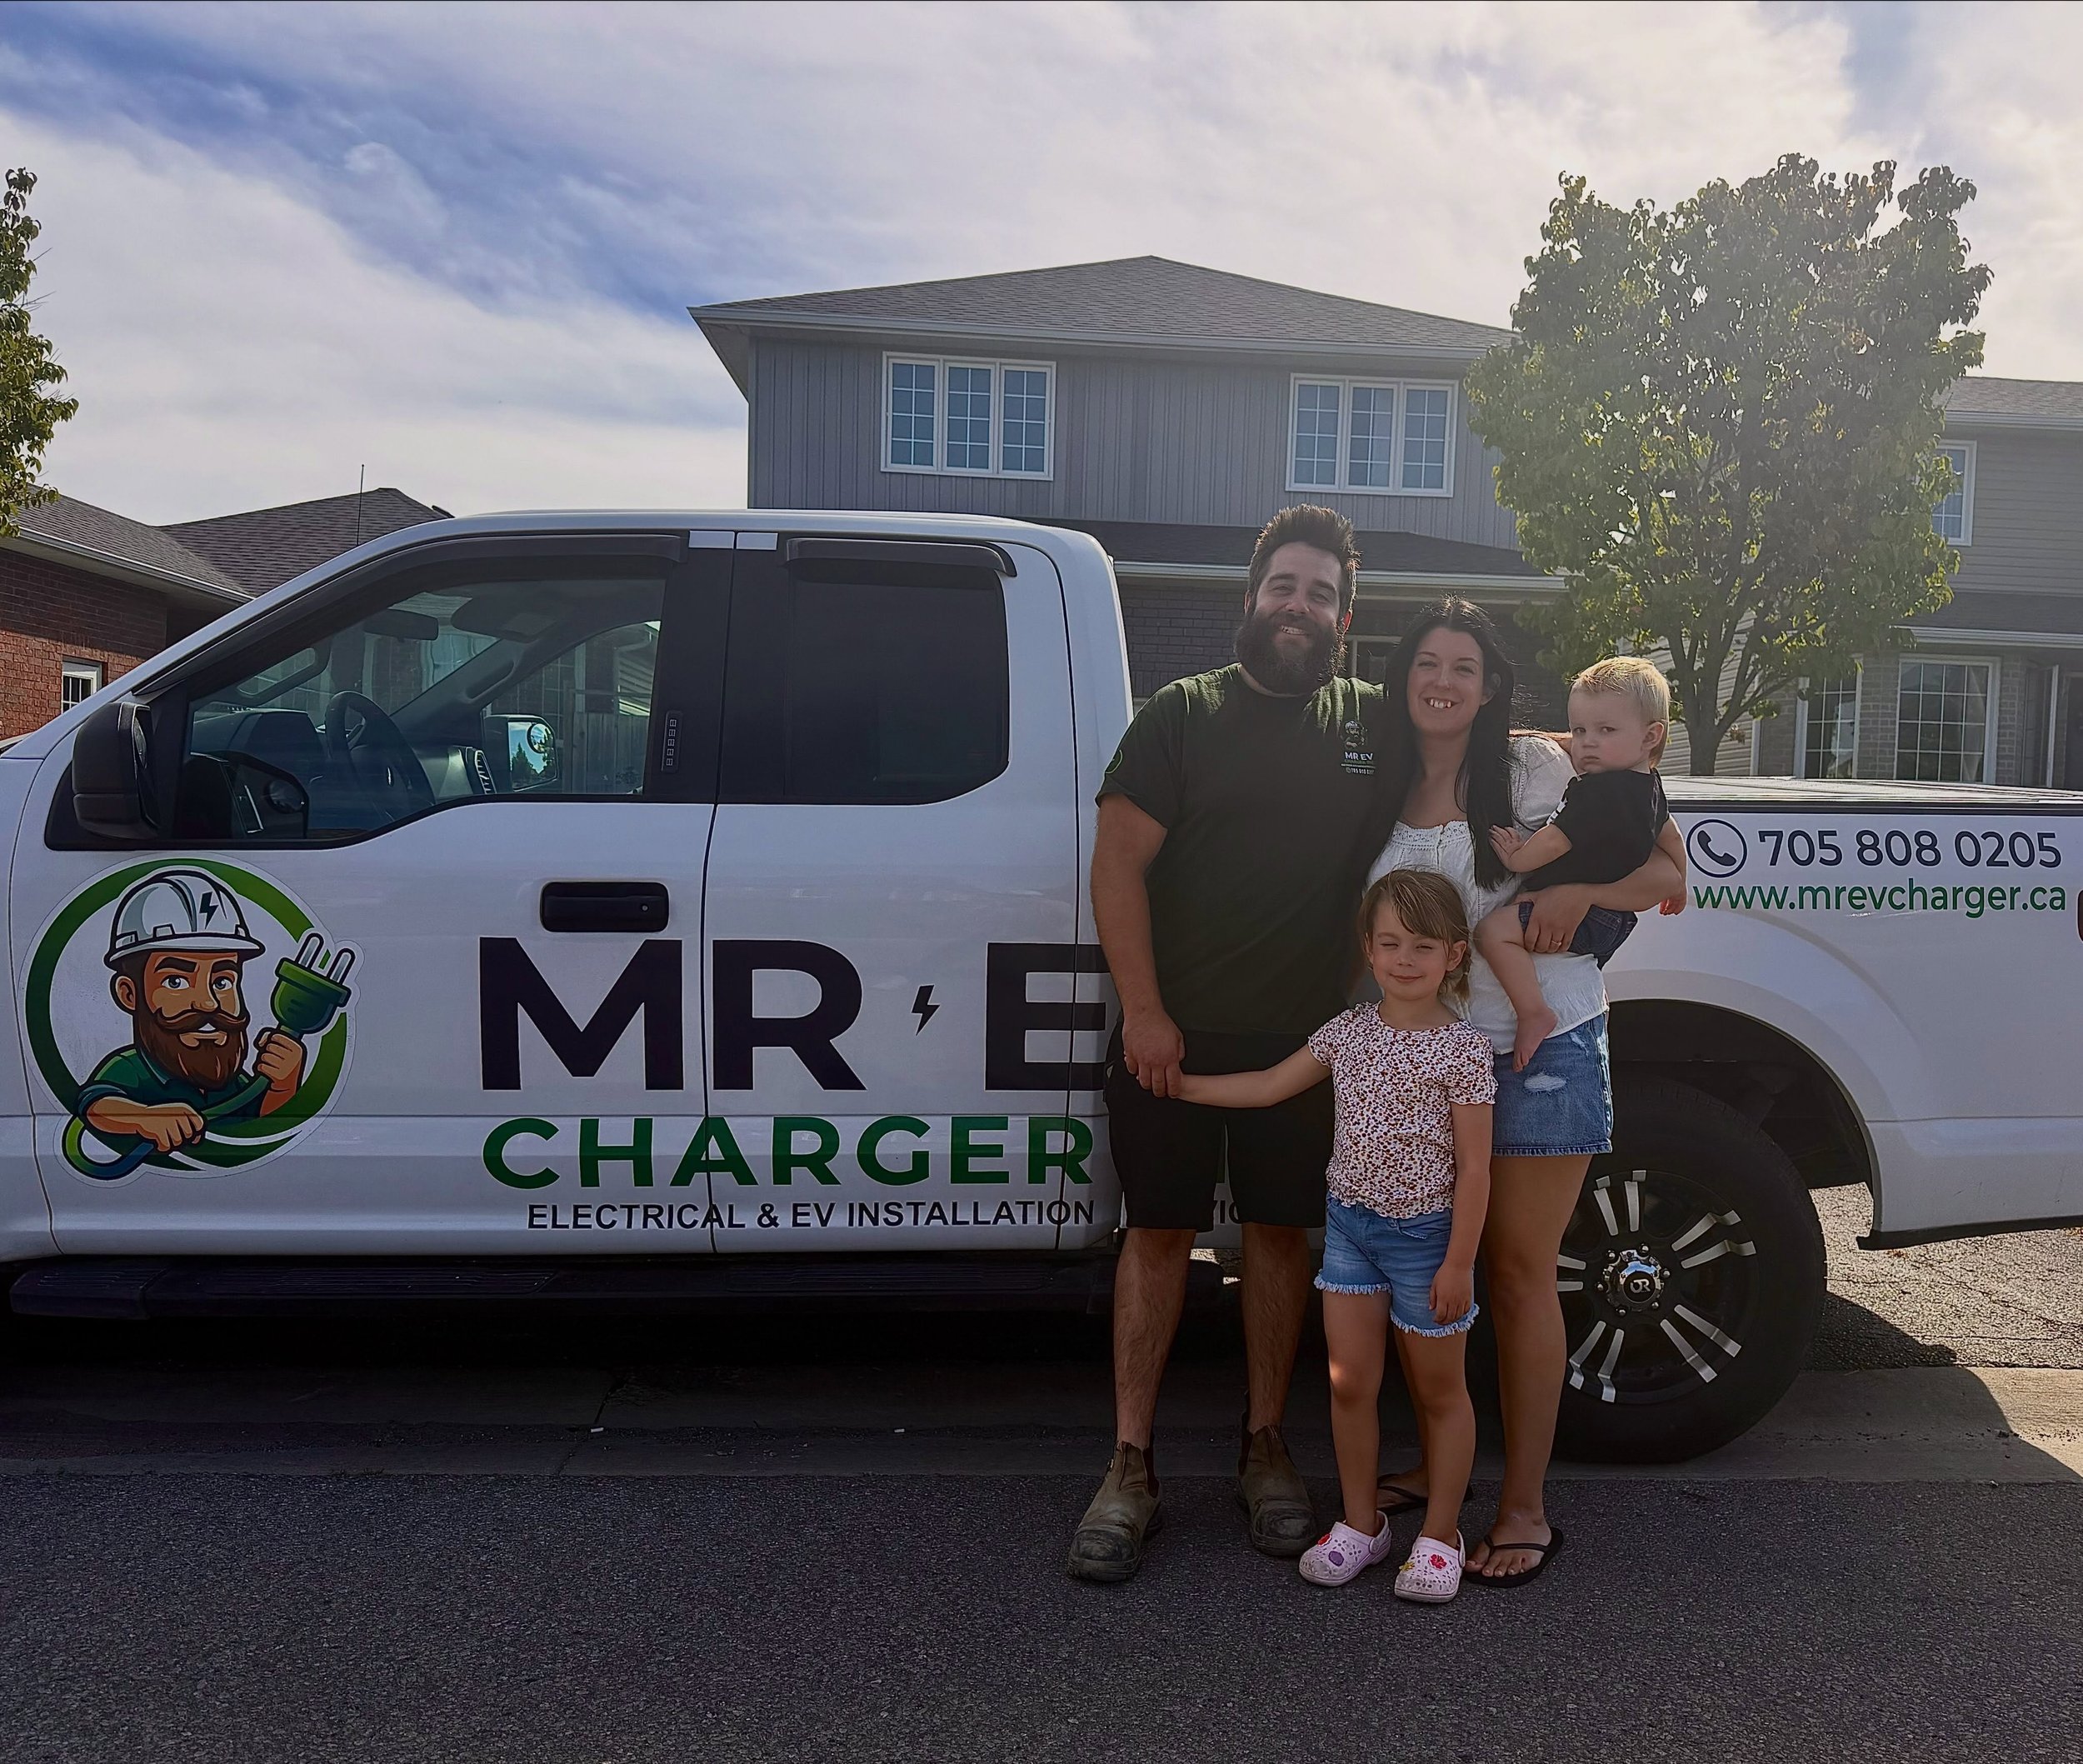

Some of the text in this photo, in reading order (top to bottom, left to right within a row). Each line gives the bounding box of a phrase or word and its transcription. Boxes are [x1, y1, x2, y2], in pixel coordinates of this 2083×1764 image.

[1344, 752, 1373, 761] MR EV
[1758, 829, 2062, 868] 705 808 0205
[1693, 878, 2066, 918] www.mrevcharger.ca
[479, 937, 867, 1092] MR
[482, 1115, 1093, 1189] CHARGER
[527, 1199, 1095, 1229] ELECTRICAL & EV INSTALLATION
